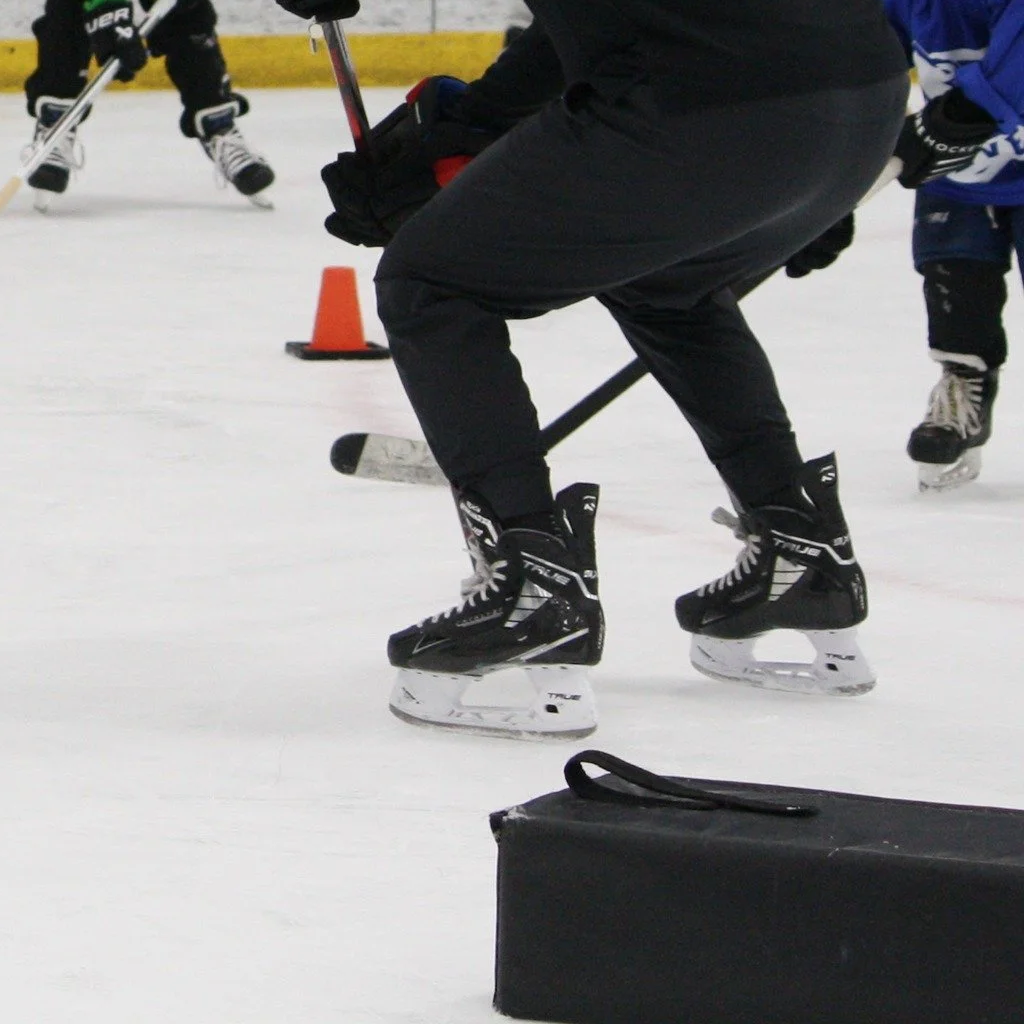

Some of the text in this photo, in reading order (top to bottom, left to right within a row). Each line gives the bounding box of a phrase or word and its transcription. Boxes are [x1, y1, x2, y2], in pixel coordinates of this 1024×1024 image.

[773, 536, 822, 558] TRUE
[522, 559, 572, 586] TRUE
[826, 652, 856, 661] TRUE
[548, 692, 582, 701] TRUE
